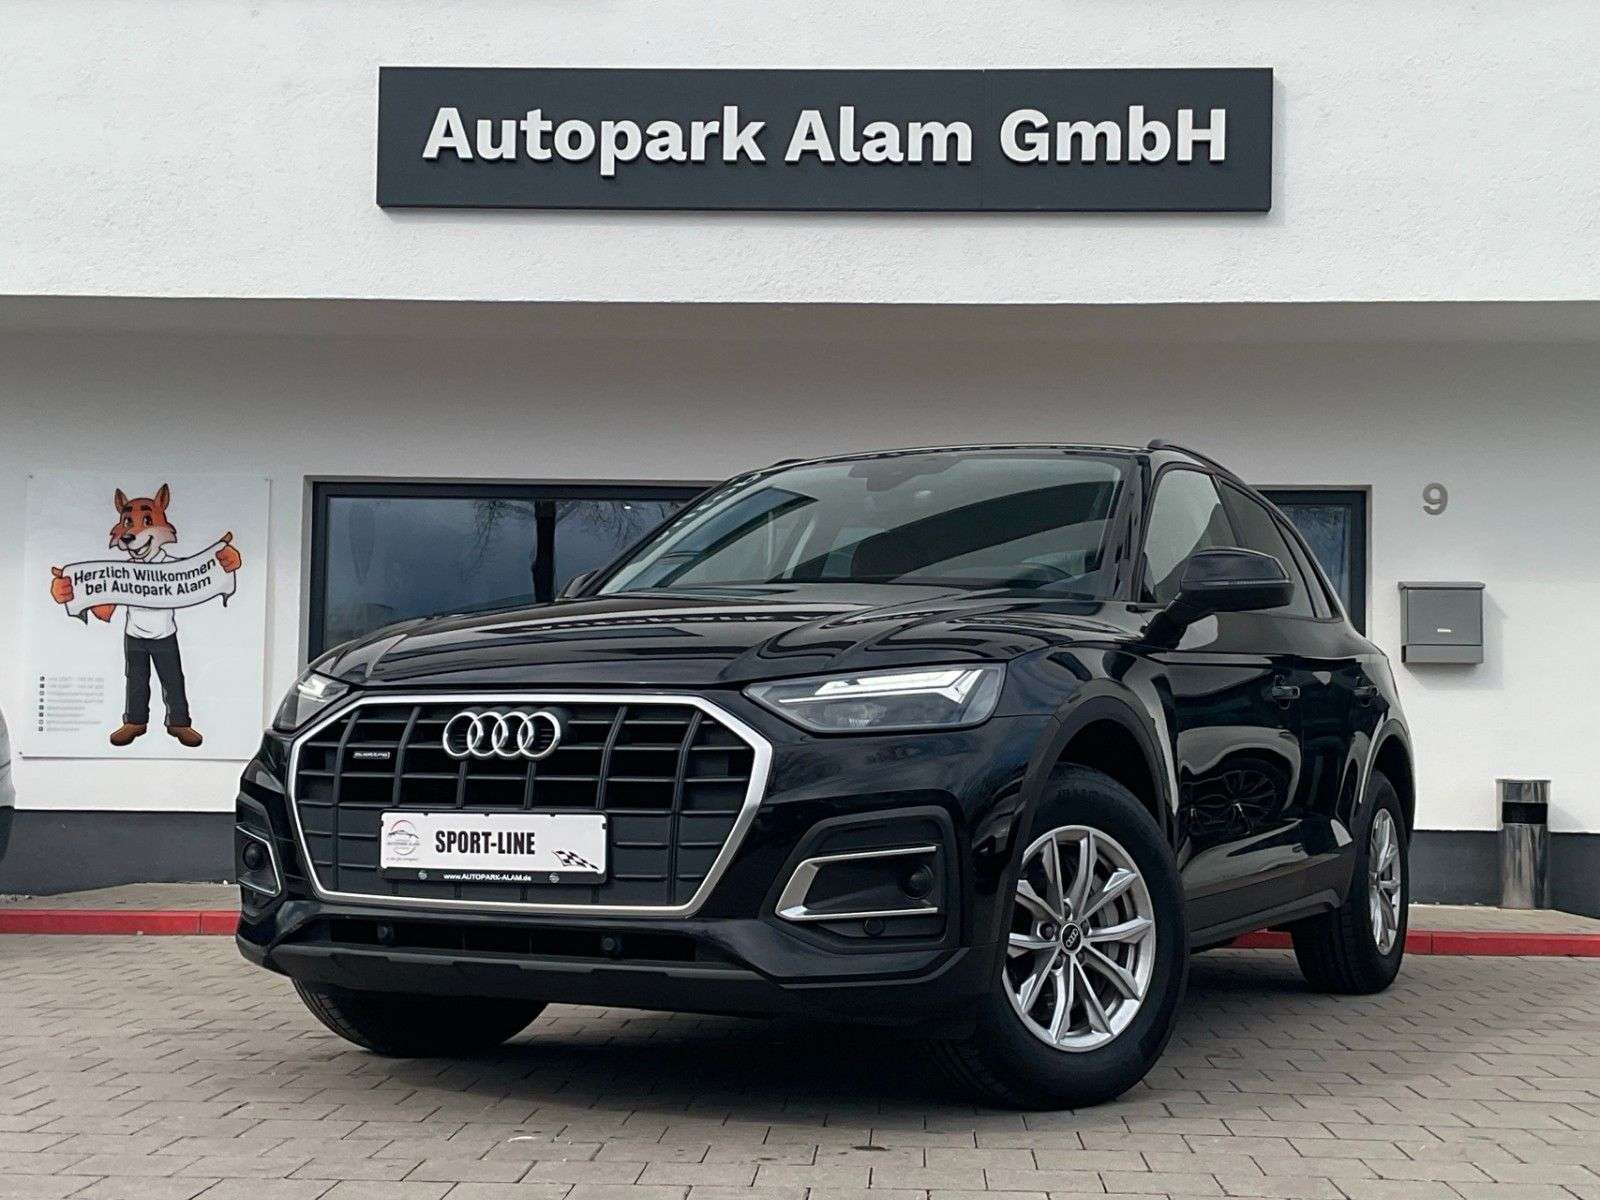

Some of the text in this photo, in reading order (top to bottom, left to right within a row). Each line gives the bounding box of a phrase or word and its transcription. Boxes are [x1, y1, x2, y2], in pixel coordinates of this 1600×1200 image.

[422, 106, 1225, 176] Autopark Alam GmbH
[1423, 482, 1448, 515] 9
[74, 558, 216, 586] Herzlich Willkommen
[85, 576, 211, 597] bei Autopark Alam
[435, 830, 536, 855] SPORT-LINE
[443, 873, 532, 881] www.AUTOPARK-ALAM.de
